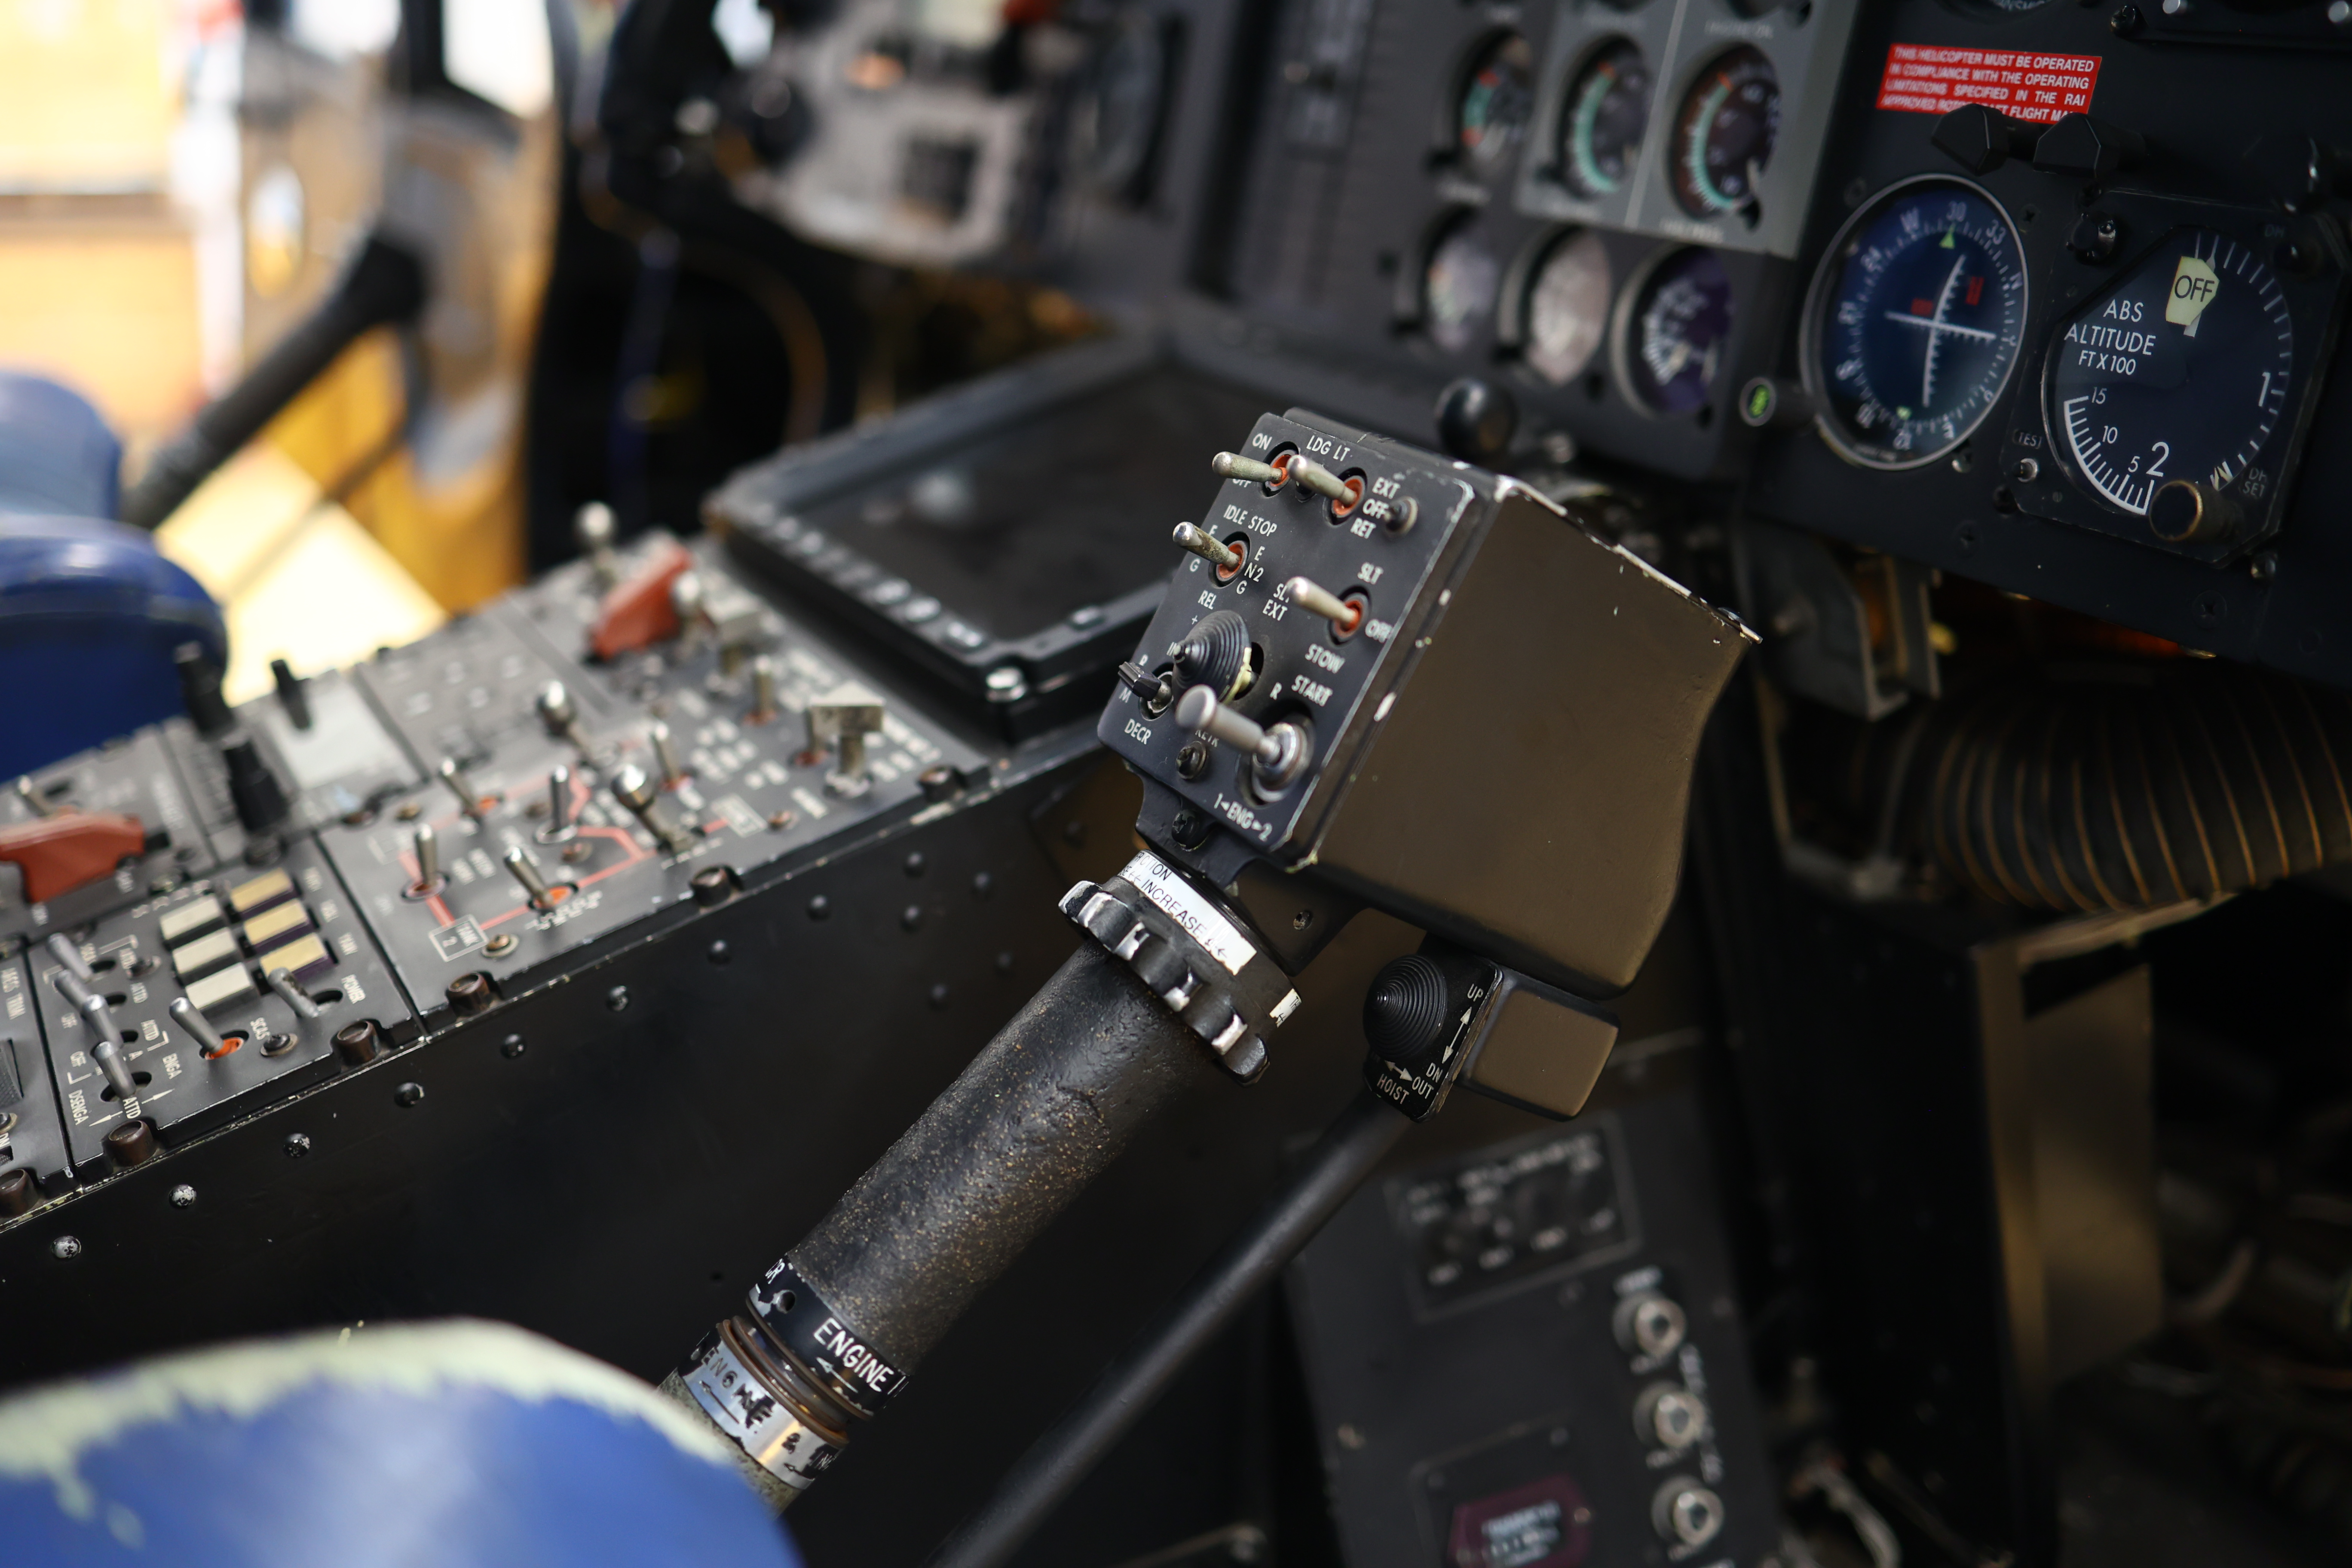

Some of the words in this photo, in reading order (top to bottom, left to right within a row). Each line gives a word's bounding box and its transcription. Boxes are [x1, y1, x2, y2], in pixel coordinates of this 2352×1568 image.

[1894, 46, 1917, 61] THIS
[1917, 48, 1983, 64] HELICOPTER
[1984, 53, 2015, 67] MUST
[2015, 55, 2032, 68] BE
[2034, 57, 2095, 72] OPERATED
[1889, 62, 1902, 75] IN
[1902, 64, 1970, 81] COMPLIANCE
[1972, 69, 1999, 83] WITH
[2001, 71, 2023, 84] THE
[2024, 73, 2090, 89] OPERATING
[1884, 78, 1948, 95] LIMITATIONS
[1953, 84, 2009, 100] SPECIFIED
[2015, 89, 2029, 101] IN
[2035, 91, 2058, 104] THE
[2064, 93, 2086, 106] RAI
[2009, 105, 2050, 120] FLIGHT
[1985, 219, 2007, 245] 33
[2174, 275, 2215, 303] OFF
[2103, 299, 2144, 323] ABS
[2064, 322, 2156, 356] ALTITUDE
[2078, 349, 2097, 367] FT
[2091, 387, 2107, 405] 15
[2258, 371, 2272, 407] 1
[1252, 432, 1272, 450] ON
[2101, 426, 2118, 444] 10
[1306, 435, 1332, 455] LDG
[1333, 444, 1351, 461] LT
[2146, 441, 2170, 477] 2
[2128, 456, 2141, 472] 5
[1372, 476, 1402, 499] EXT
[1223, 504, 1248, 525] IDLE
[1248, 515, 1278, 537] STOP
[1363, 497, 1389, 520] OFF
[1351, 518, 1376, 540] RET
[1189, 558, 1200, 573] G
[1244, 565, 1264, 582] N2
[1197, 590, 1217, 610] REL
[1236, 581, 1248, 595] G
[1273, 583, 1290, 603] SL
[1262, 599, 1288, 622] EXT
[1305, 643, 1346, 674] STOW
[1269, 682, 1283, 700] R
[1291, 674, 1333, 707] START
[1124, 718, 1152, 745] DECR
[1226, 801, 1255, 830] ENG
[1135, 851, 1173, 881] FRICTION
[1141, 878, 1209, 939] INCREASE
[341, 974, 367, 1004] POWER
[1467, 983, 1484, 1002] UP
[140, 1019, 161, 1042] ATTD
[250, 1017, 271, 1041] SCAS
[70, 1050, 86, 1068] OFF
[162, 1052, 183, 1080] ENGA
[1426, 1063, 1444, 1083] DN
[1376, 1073, 1410, 1105] HOIST
[1412, 1076, 1435, 1099] OUT
[68, 1089, 89, 1126] DSENGA
[122, 1096, 142, 1120] ATTD
[814, 1317, 895, 1393] ENGINE
